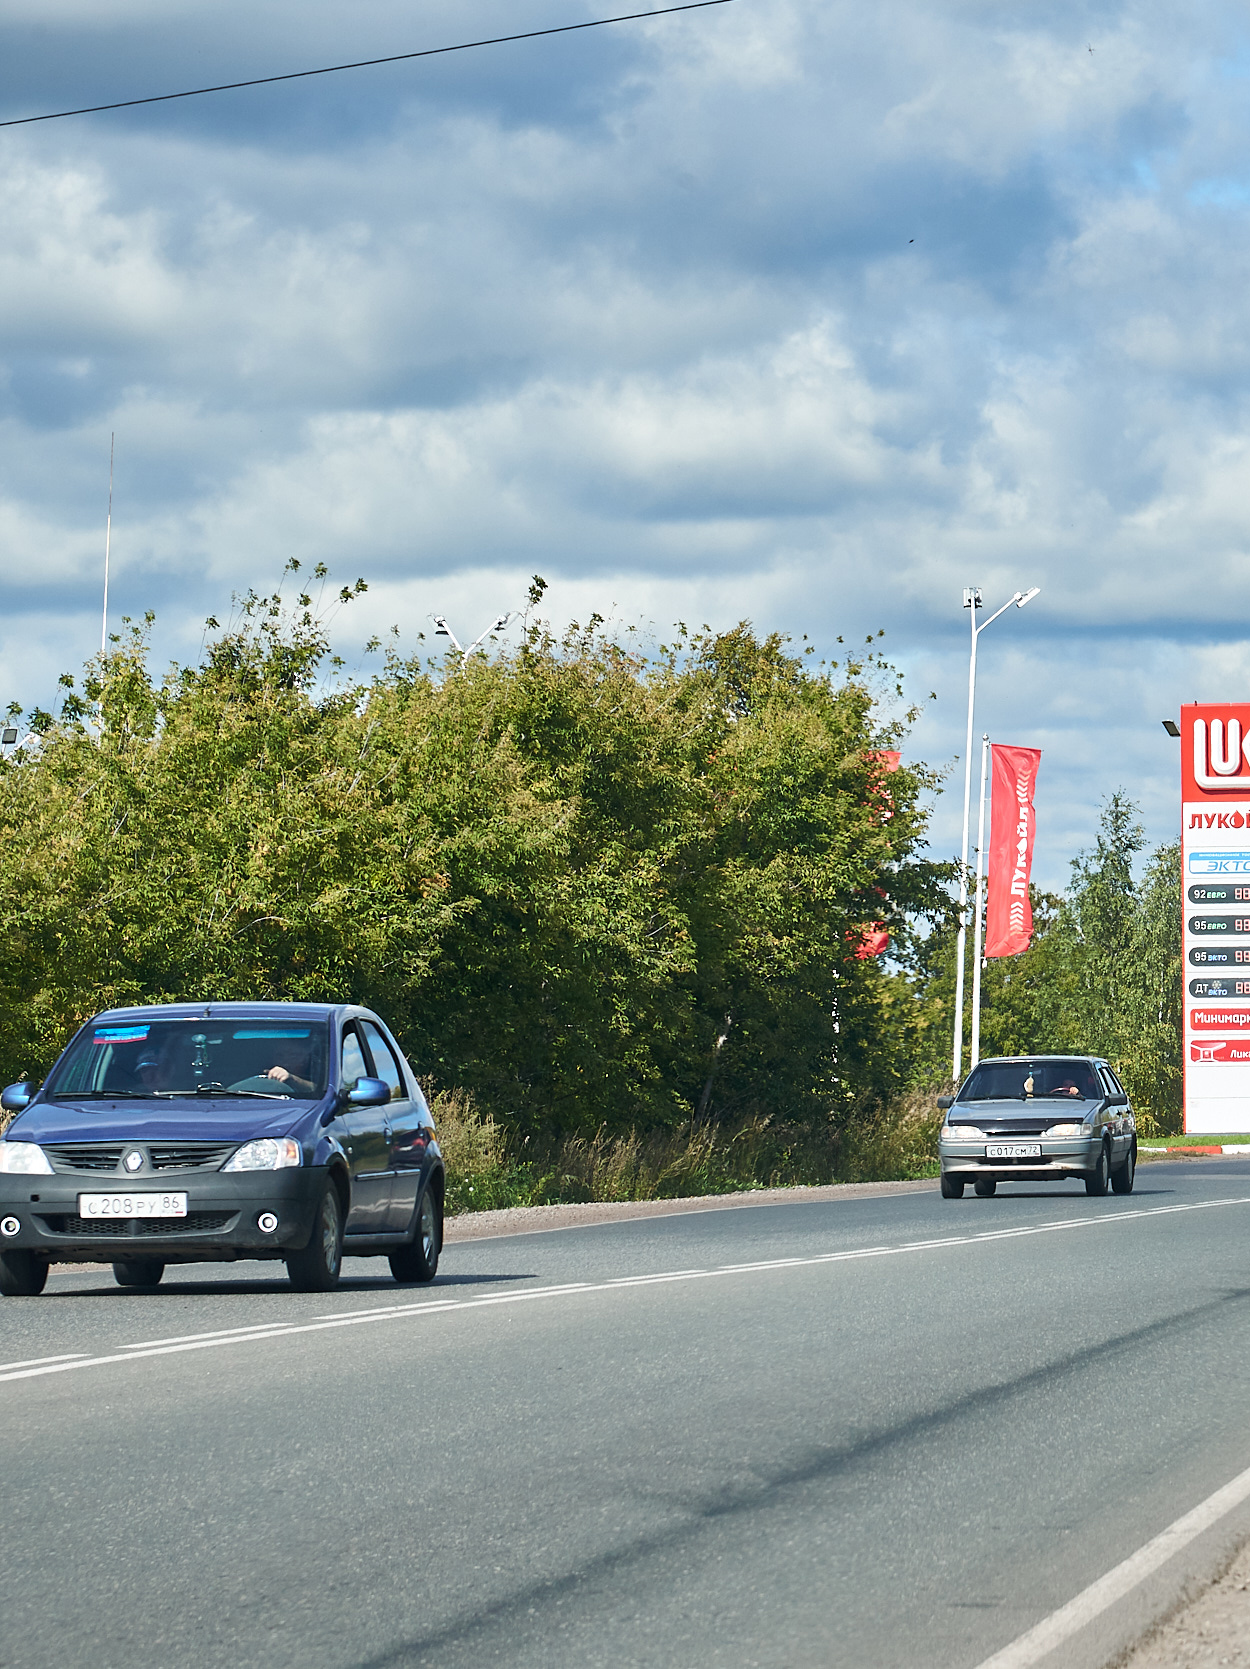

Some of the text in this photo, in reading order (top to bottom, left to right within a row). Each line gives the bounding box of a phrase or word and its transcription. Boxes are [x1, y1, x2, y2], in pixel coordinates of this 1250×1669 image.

[1010, 806, 1029, 898] ЛУКОЙЛ
[1193, 889, 1206, 899] 92
[1194, 920, 1207, 930] 95
[1194, 951, 1207, 962] 95
[1195, 983, 1209, 995] ДТ
